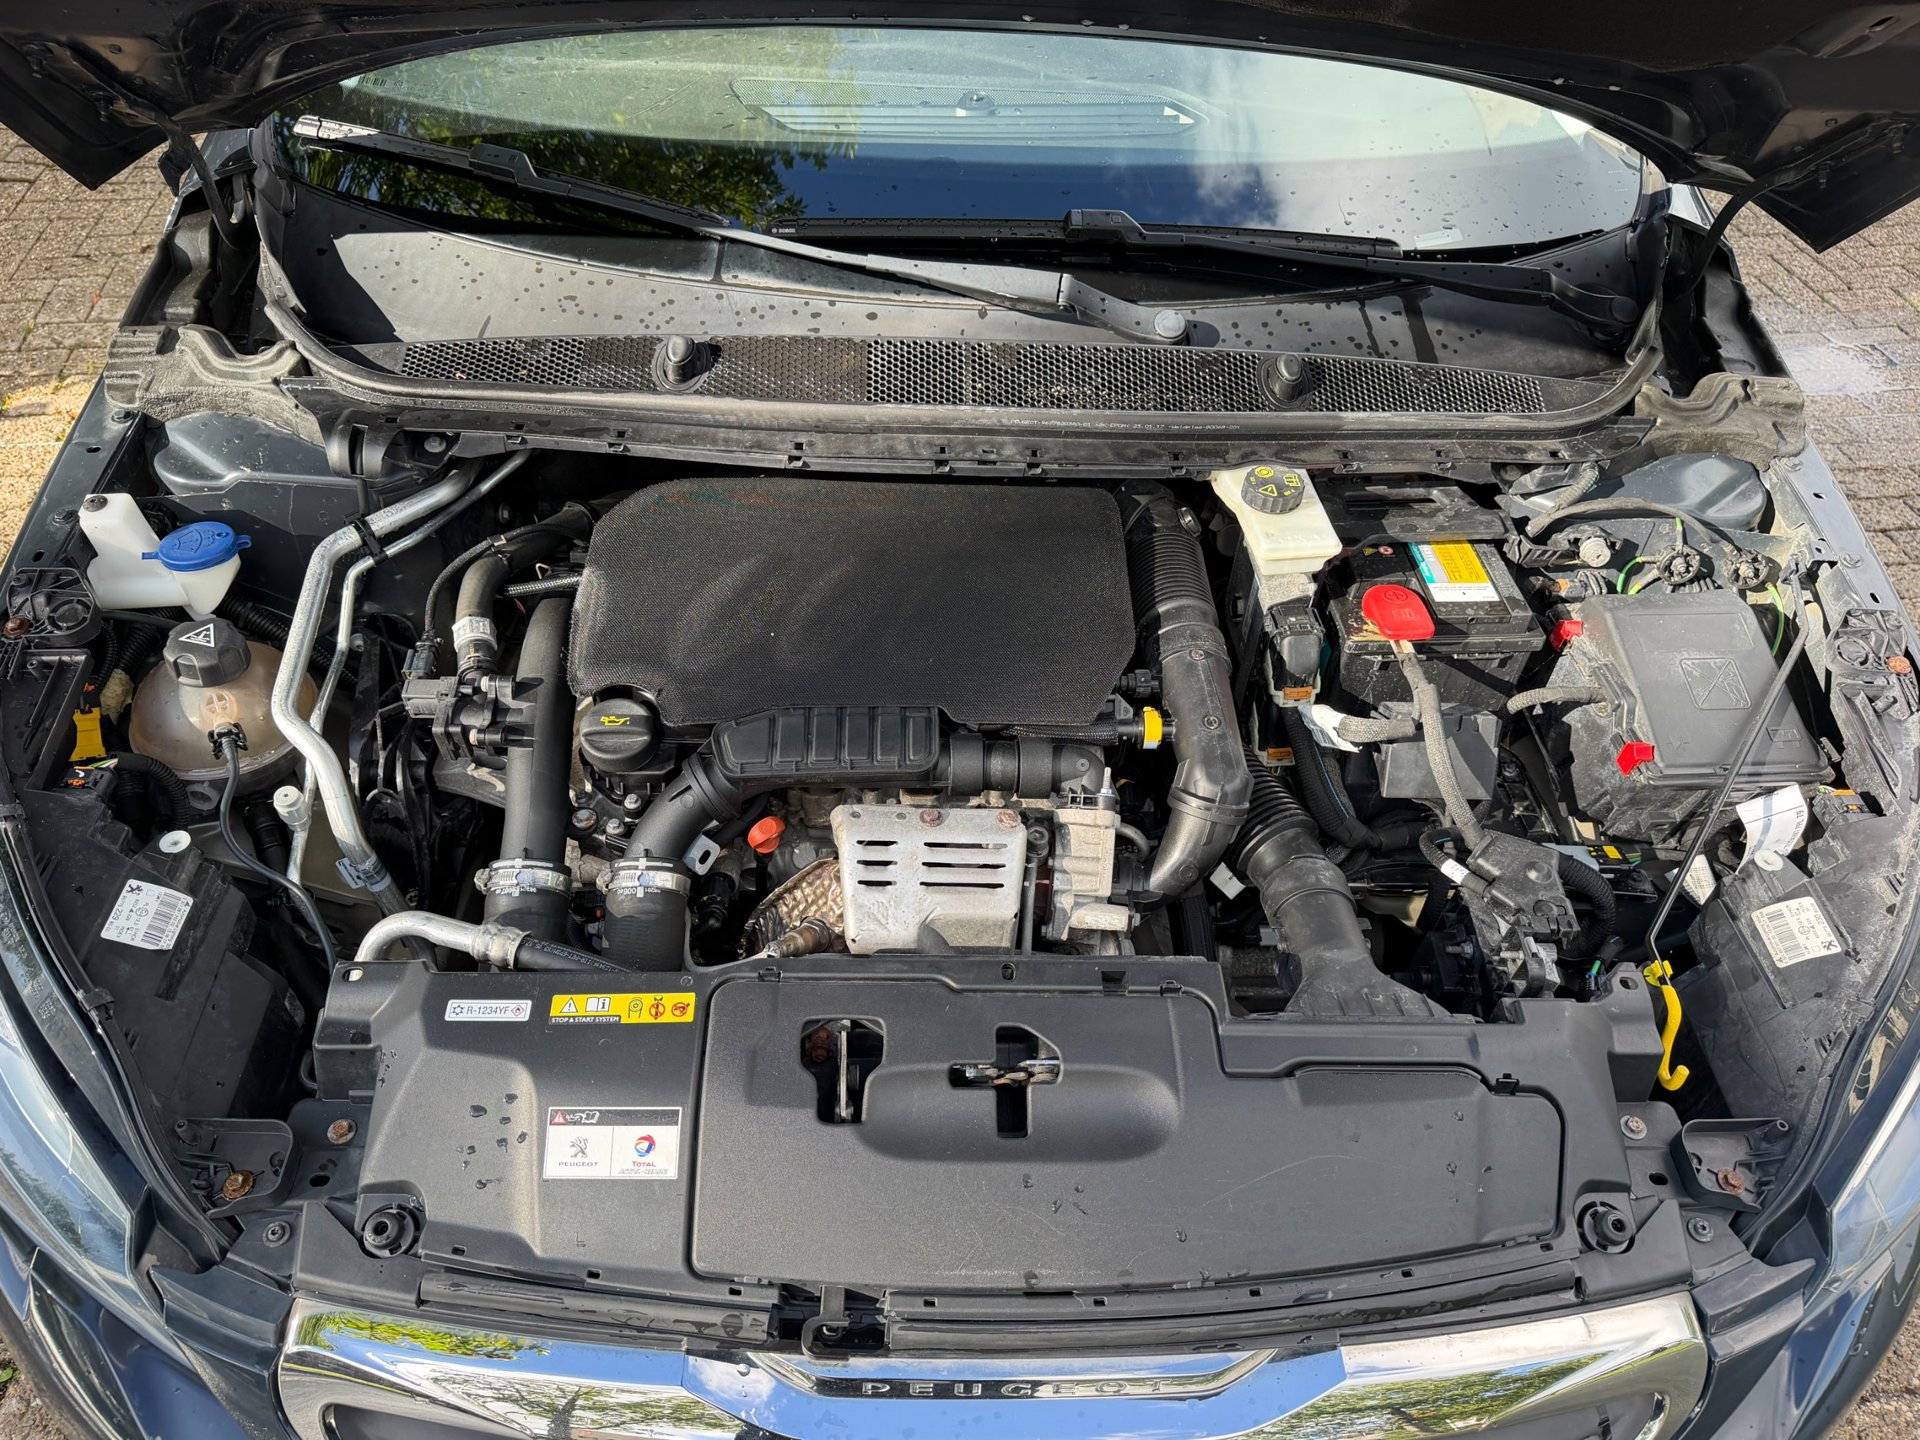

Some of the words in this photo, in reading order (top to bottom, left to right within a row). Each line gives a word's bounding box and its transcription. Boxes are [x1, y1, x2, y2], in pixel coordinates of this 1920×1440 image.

[111, 907, 123, 921] 229
[466, 1004, 510, 1015] R-1234YF
[595, 1015, 620, 1023] SYSTEM
[861, 1378, 1173, 1397] PEUGEOT
